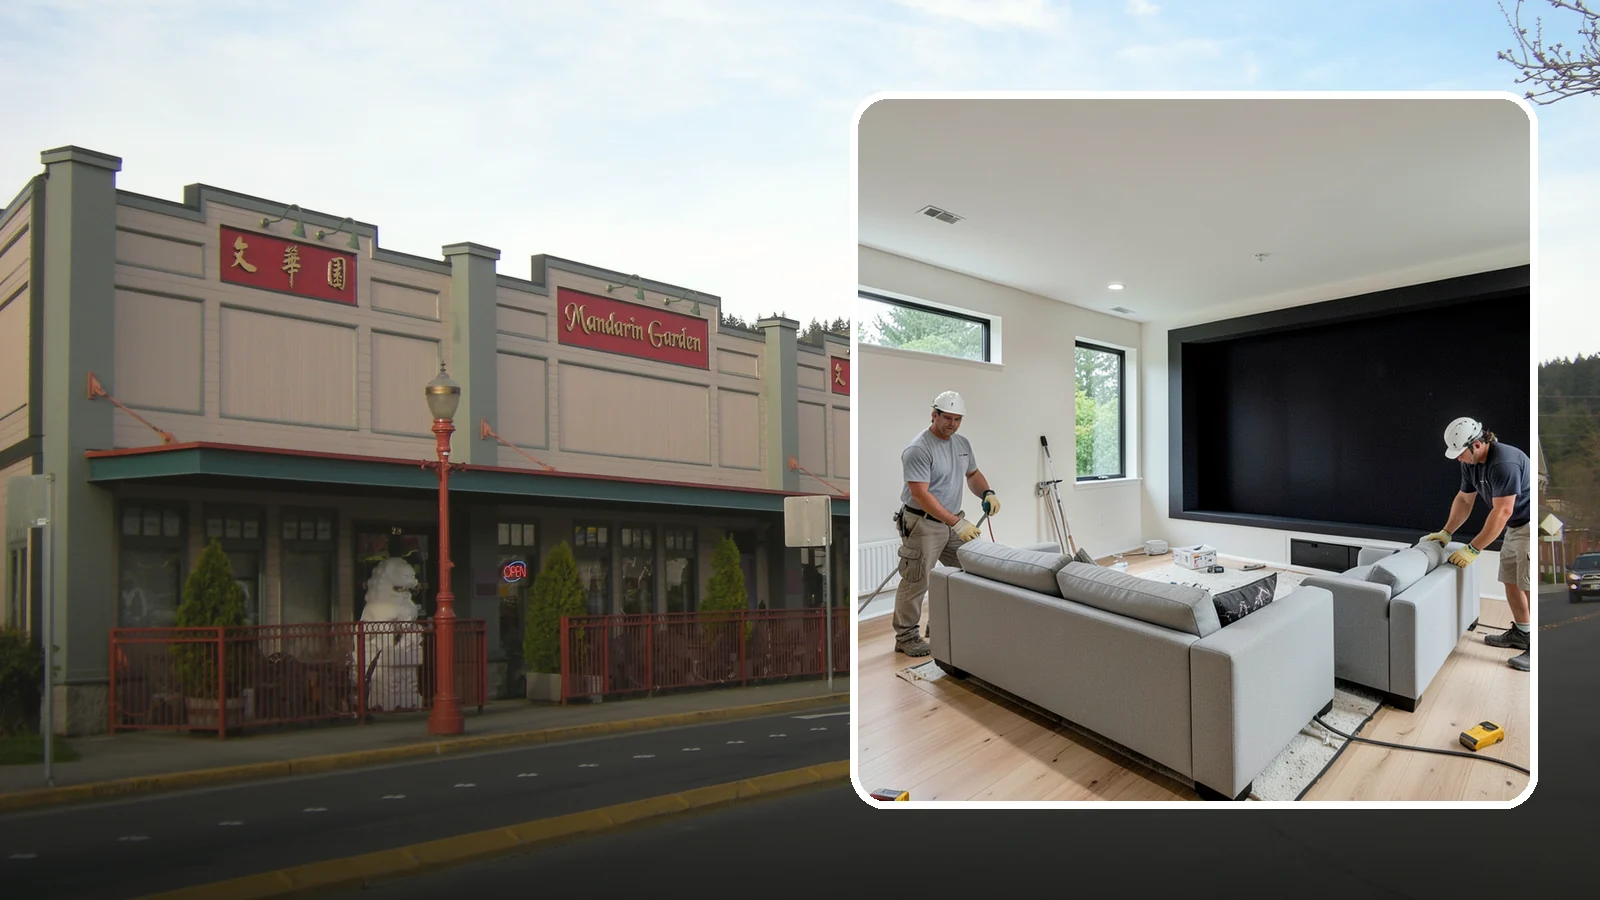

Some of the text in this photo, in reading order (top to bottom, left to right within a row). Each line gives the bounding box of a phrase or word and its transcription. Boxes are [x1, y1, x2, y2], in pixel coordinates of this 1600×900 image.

[230, 235, 347, 291] 文華園
[564, 302, 702, 352] Mandarin Garden
[503, 565, 527, 578] OPEN
